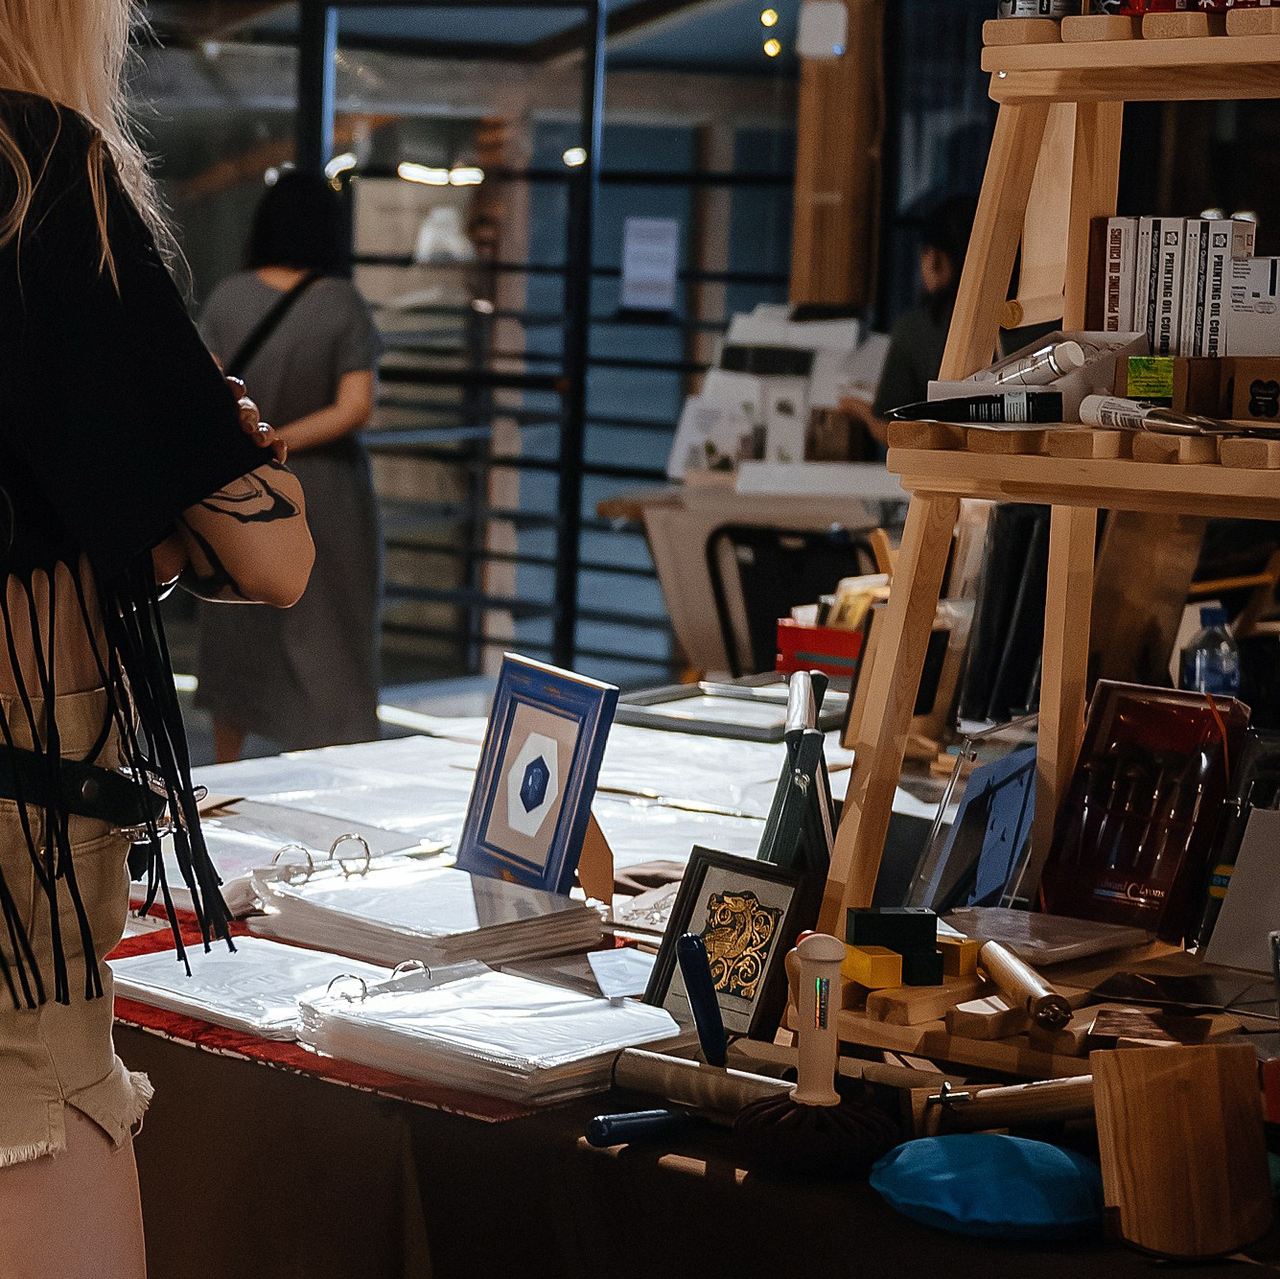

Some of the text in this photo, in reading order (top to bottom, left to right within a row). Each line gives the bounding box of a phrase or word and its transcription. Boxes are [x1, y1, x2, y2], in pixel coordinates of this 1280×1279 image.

[1110, 229, 1122, 259] COLORS
[1109, 262, 1120, 273] OIL
[1108, 276, 1120, 313] PRINTING
[1160, 252, 1174, 356] PRINTING OIL COLORS
[1208, 255, 1223, 357] PRINTING OIL COLORS
